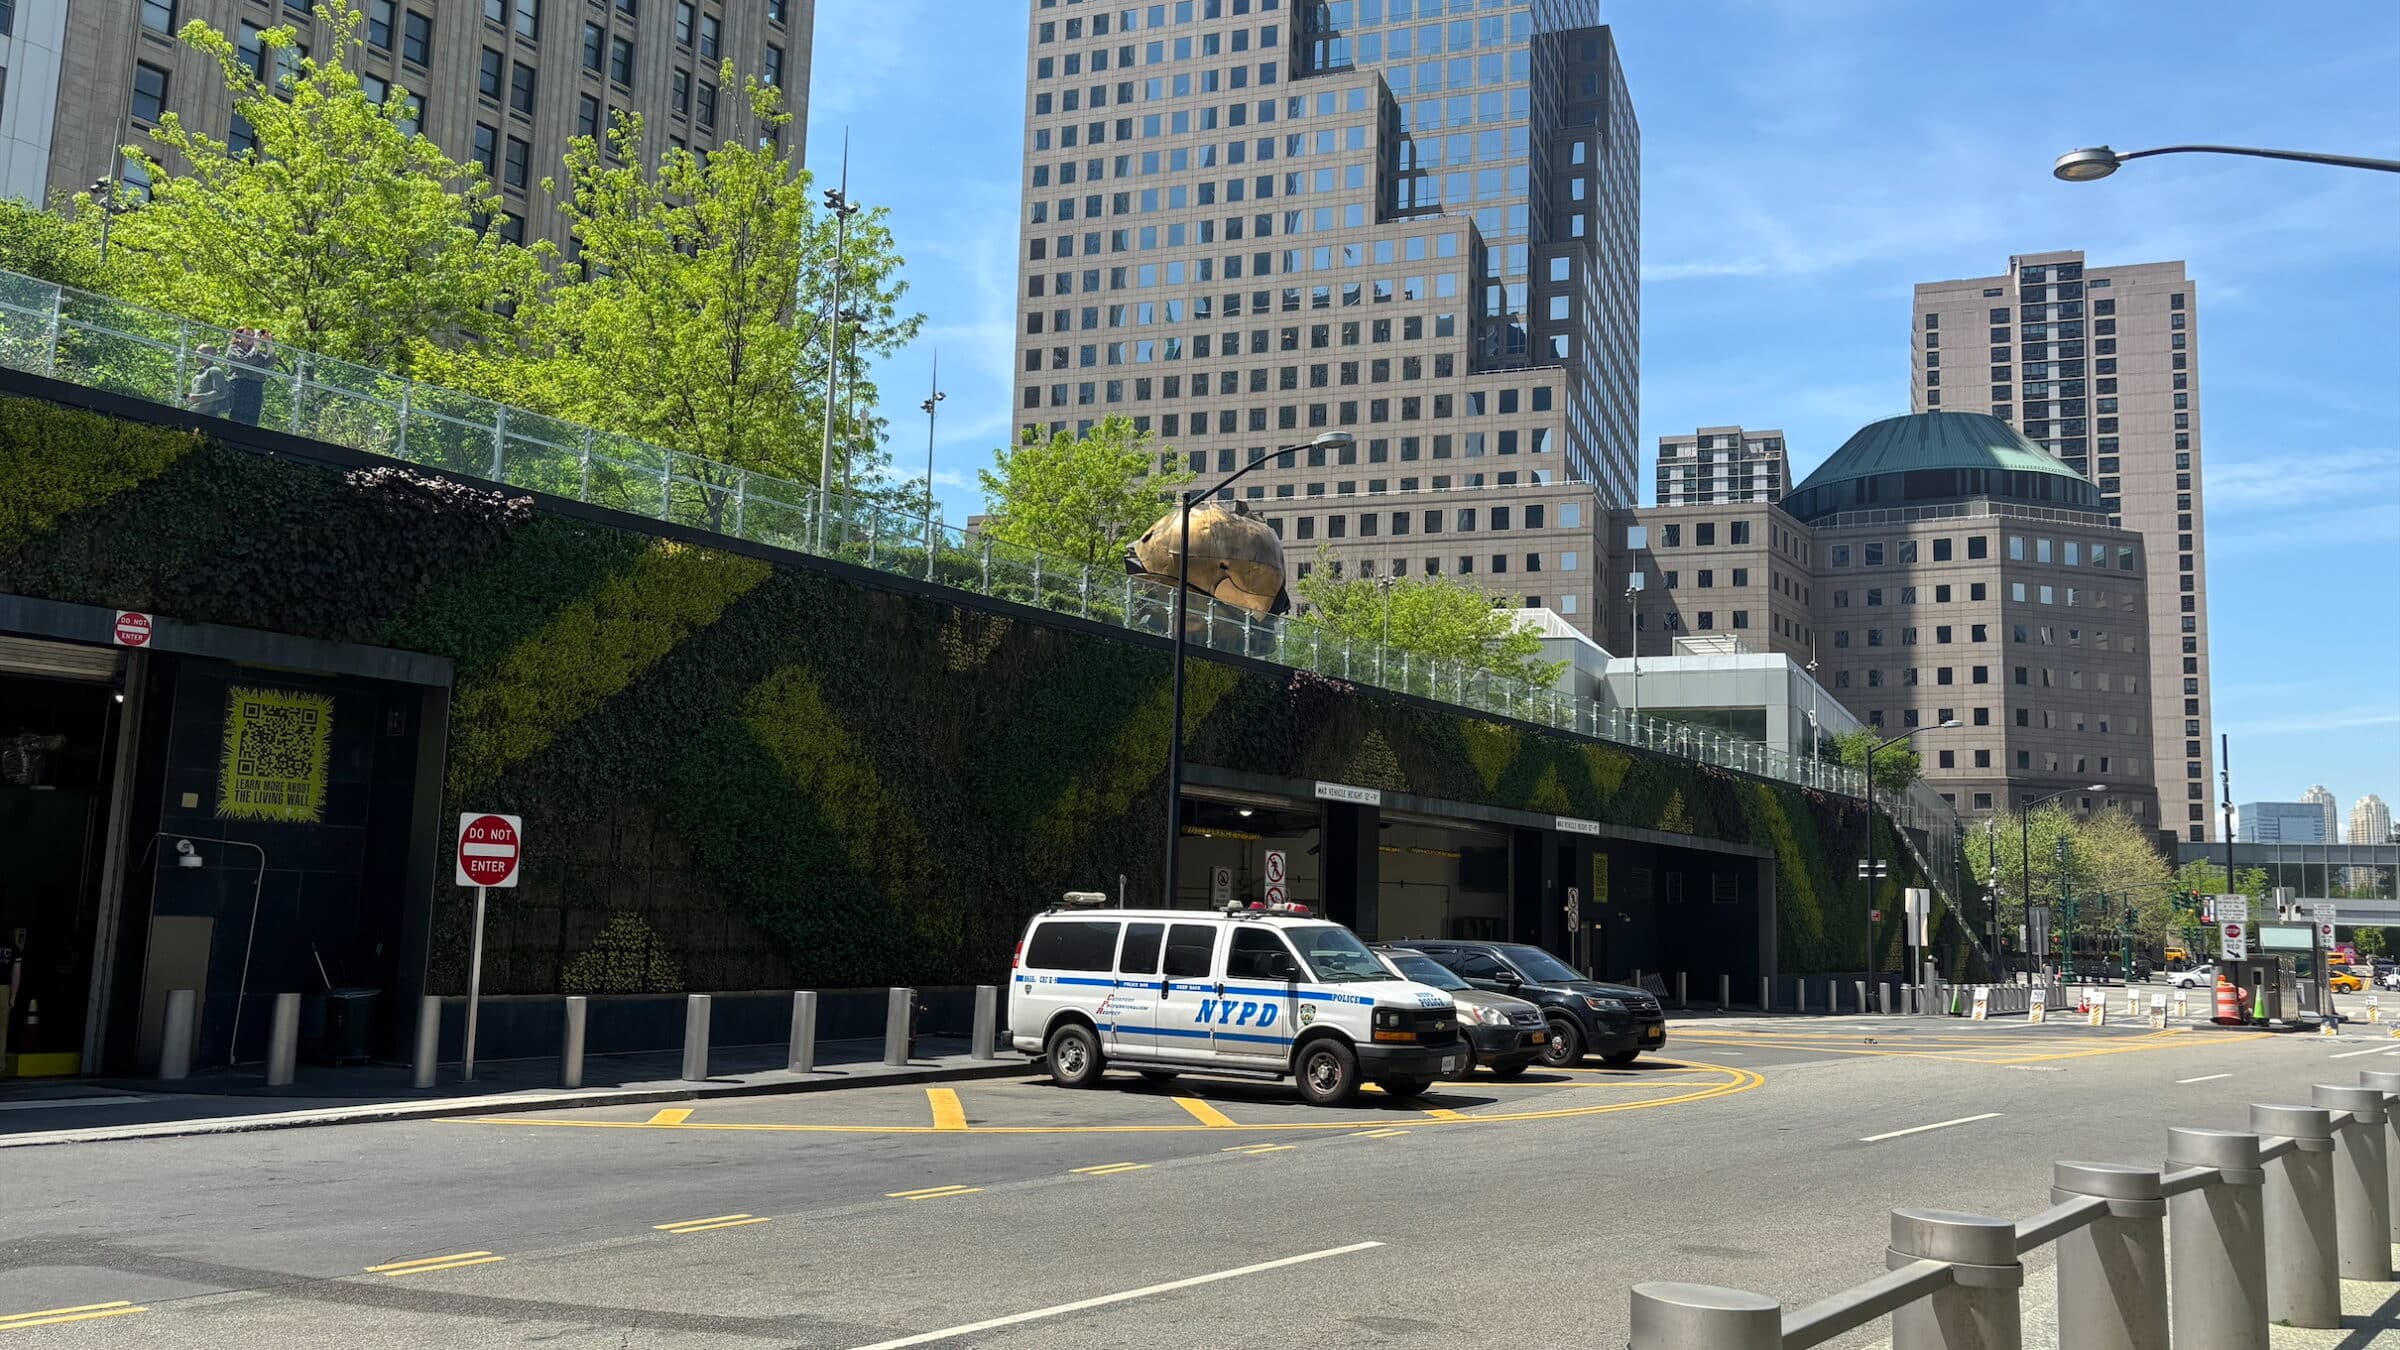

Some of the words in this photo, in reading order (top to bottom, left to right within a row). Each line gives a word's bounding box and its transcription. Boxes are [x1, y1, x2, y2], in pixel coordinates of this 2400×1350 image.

[122, 632, 143, 641] ENTER
[236, 779, 260, 791] LEARN
[264, 780, 285, 793] MORE
[287, 782, 311, 794] ABOUT
[235, 789, 251, 802] THE
[254, 791, 284, 805] LIVING
[287, 793, 309, 807] WALL
[469, 827, 485, 839] DO
[490, 828, 512, 841] NOT
[471, 860, 506, 873] ENTER
[1332, 993, 1361, 1004] POLICE
[1417, 997, 1445, 1007] POLICE
[1194, 999, 1279, 1027] NYPD
